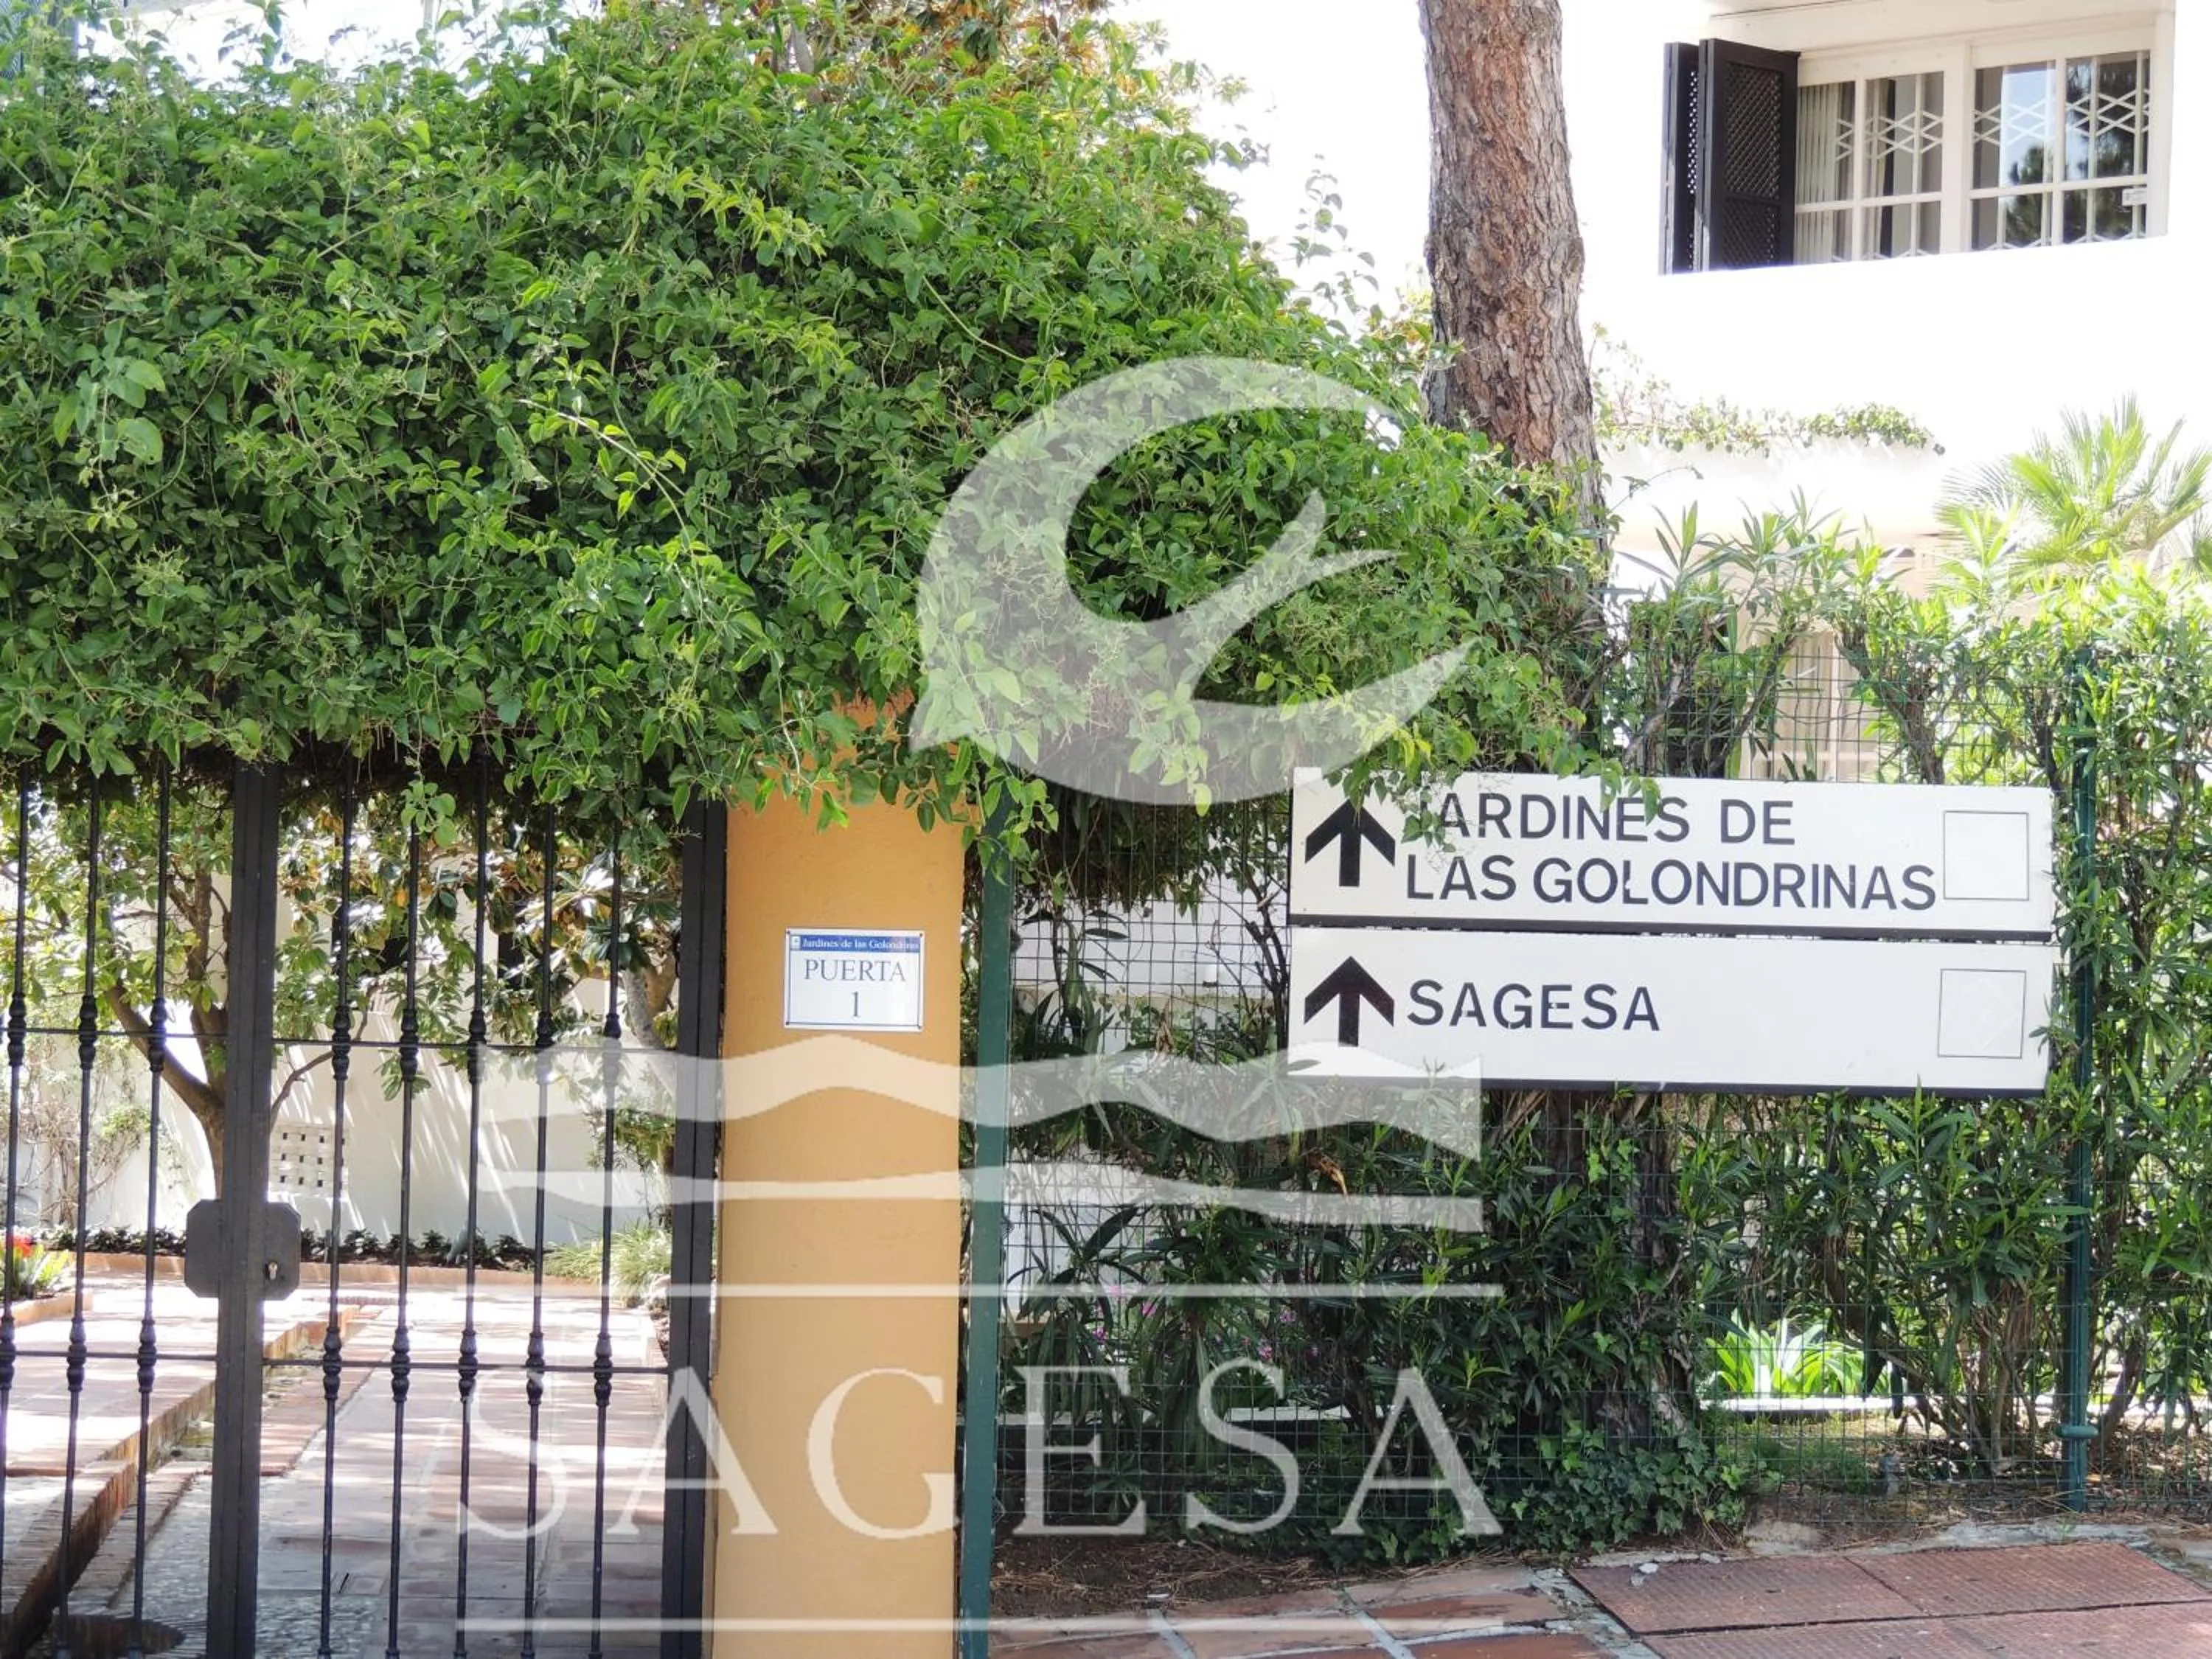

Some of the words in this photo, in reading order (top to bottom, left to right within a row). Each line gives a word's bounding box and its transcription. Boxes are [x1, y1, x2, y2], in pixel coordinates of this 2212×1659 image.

[1413, 792, 1690, 842] ARDINES
[1720, 799, 1795, 846] DE
[1407, 854, 1517, 901] LAS
[1533, 858, 1936, 911] GOLONDRINAS
[802, 937, 838, 948] Jardines
[840, 939, 852, 948] de
[855, 939, 867, 949] las
[804, 959, 906, 982] PUERTA
[852, 990, 861, 1018] 1
[1407, 979, 1660, 1032] SAGESA
